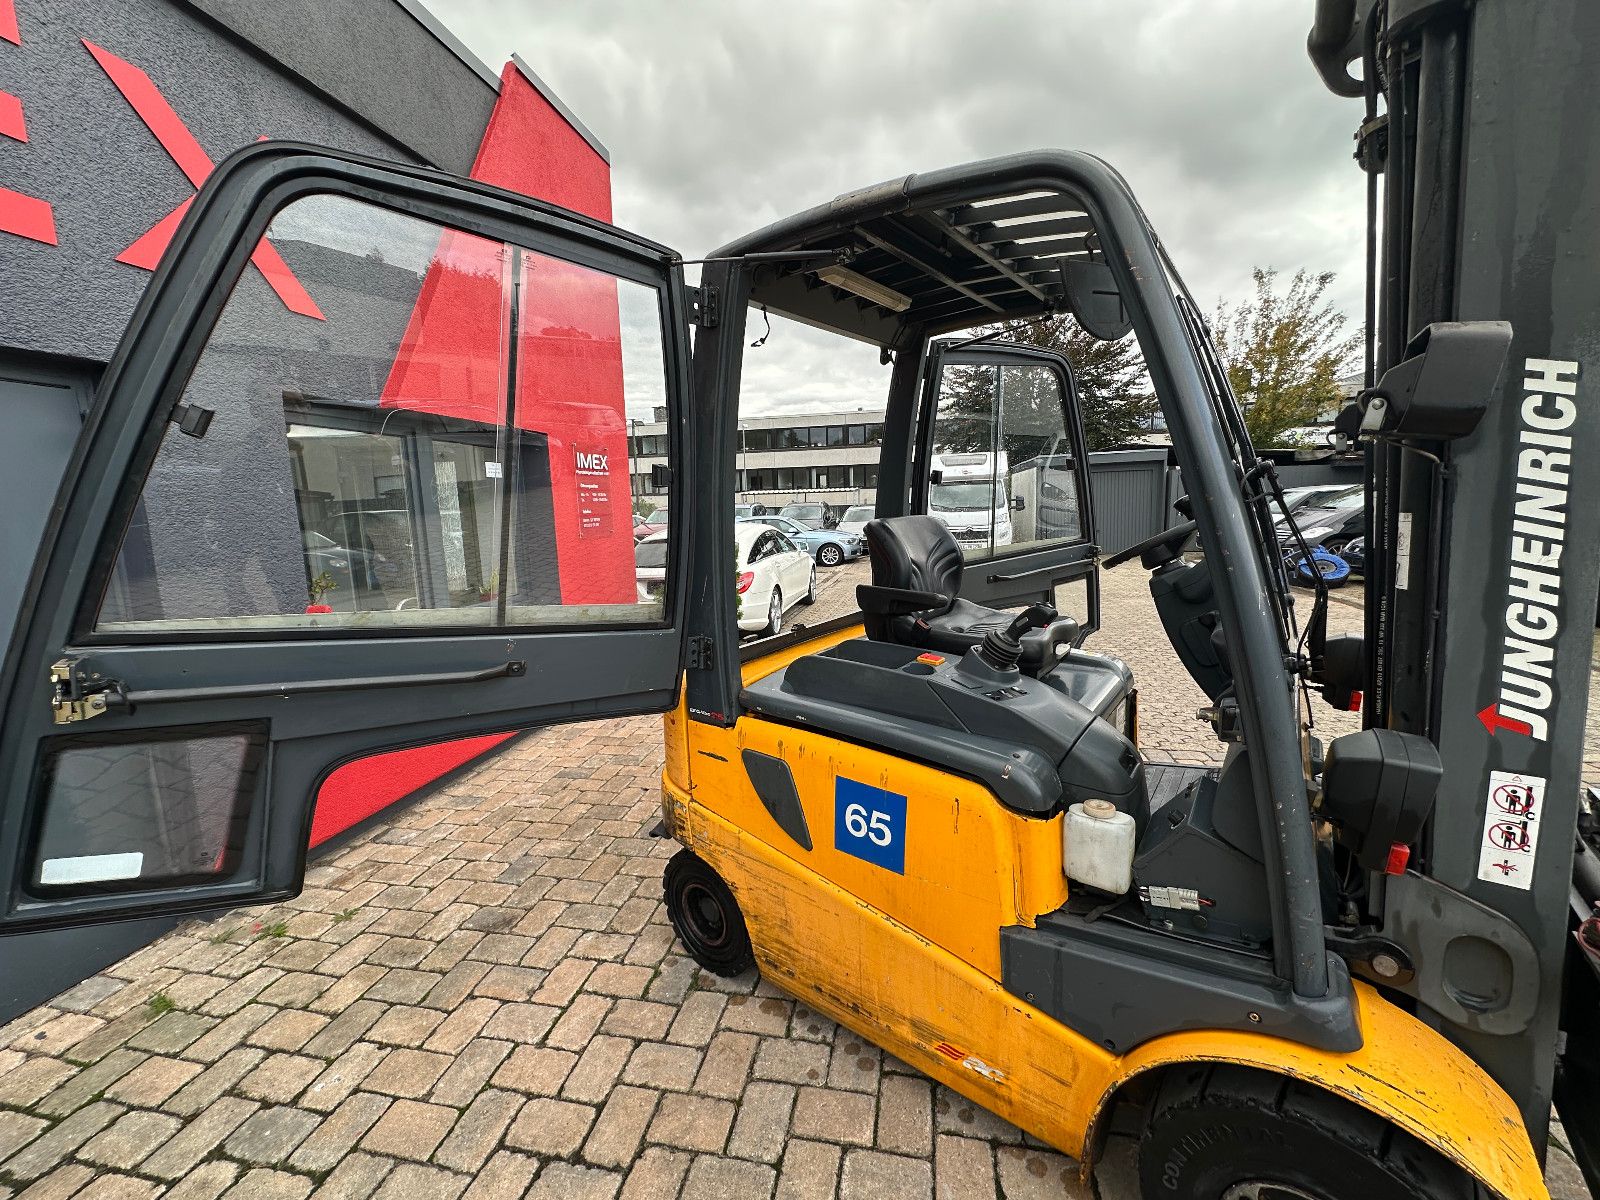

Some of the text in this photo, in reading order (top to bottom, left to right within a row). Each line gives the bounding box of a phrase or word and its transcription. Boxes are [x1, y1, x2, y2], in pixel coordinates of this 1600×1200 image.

[576, 451, 608, 470] IMEX
[1498, 357, 1579, 742] JUNGHEINRICH
[845, 803, 892, 847] 65
